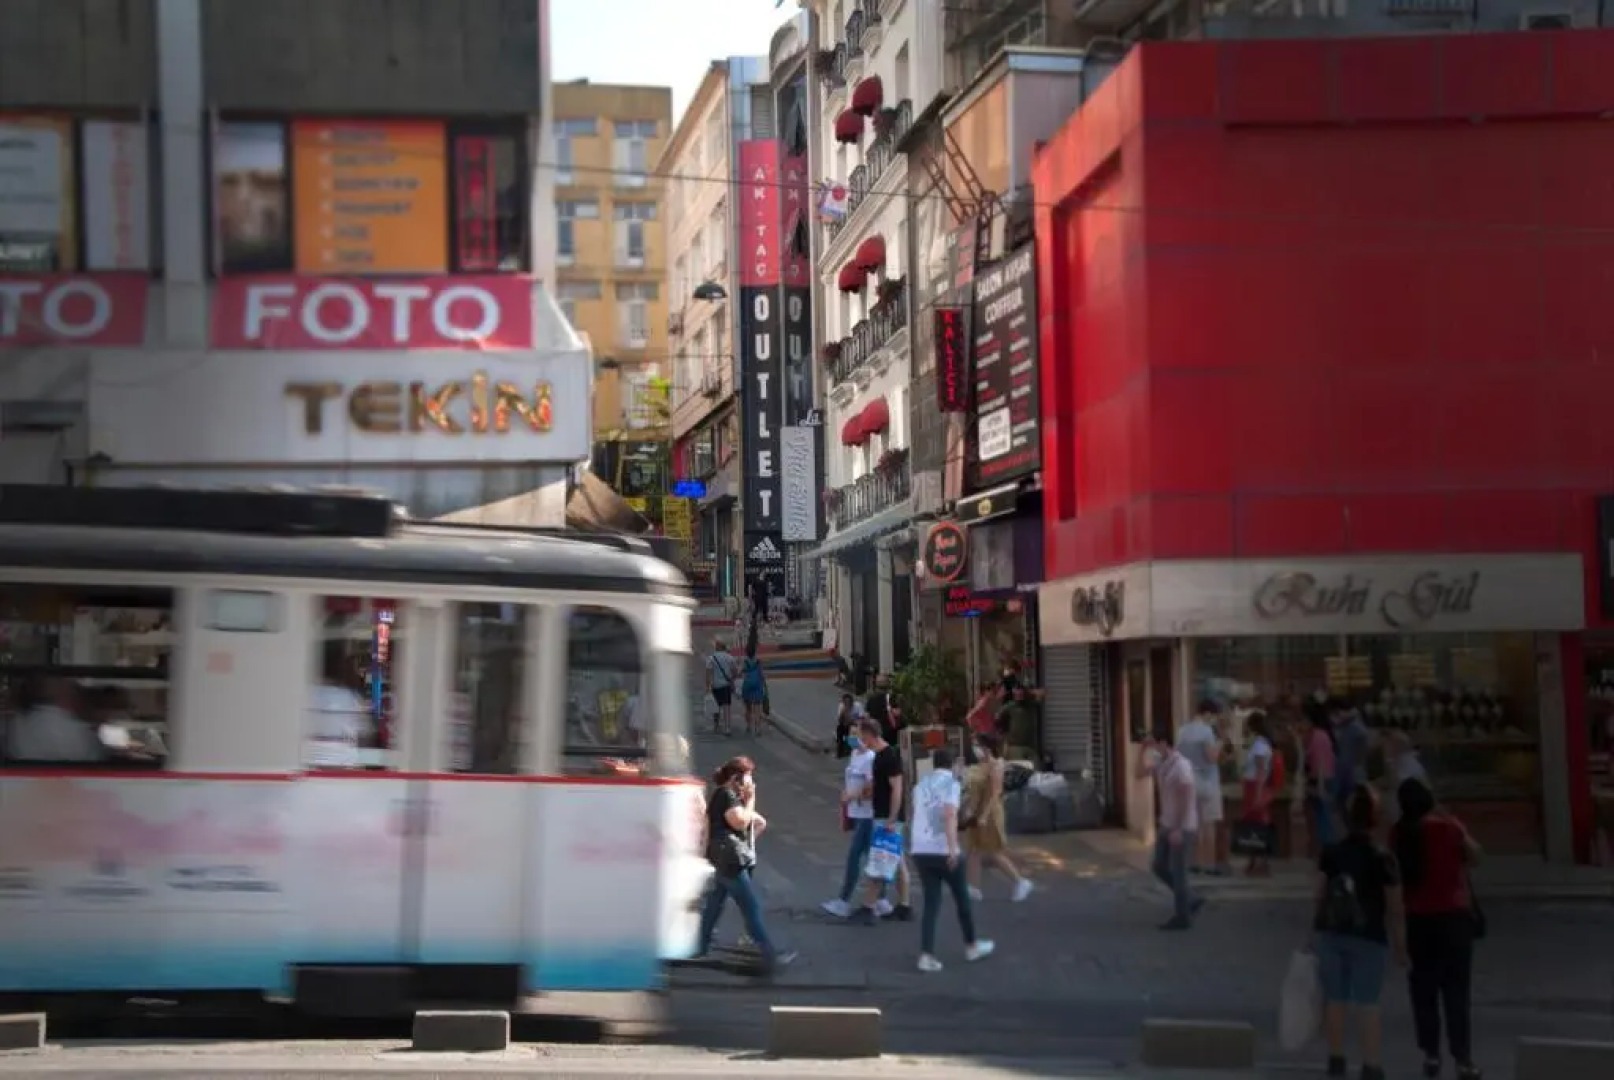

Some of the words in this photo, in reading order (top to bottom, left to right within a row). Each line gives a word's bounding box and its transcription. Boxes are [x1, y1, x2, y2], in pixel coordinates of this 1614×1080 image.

[243, 283, 500, 342] FOTO
[284, 368, 555, 435] TEKİN
[754, 294, 773, 517] OUTLET
